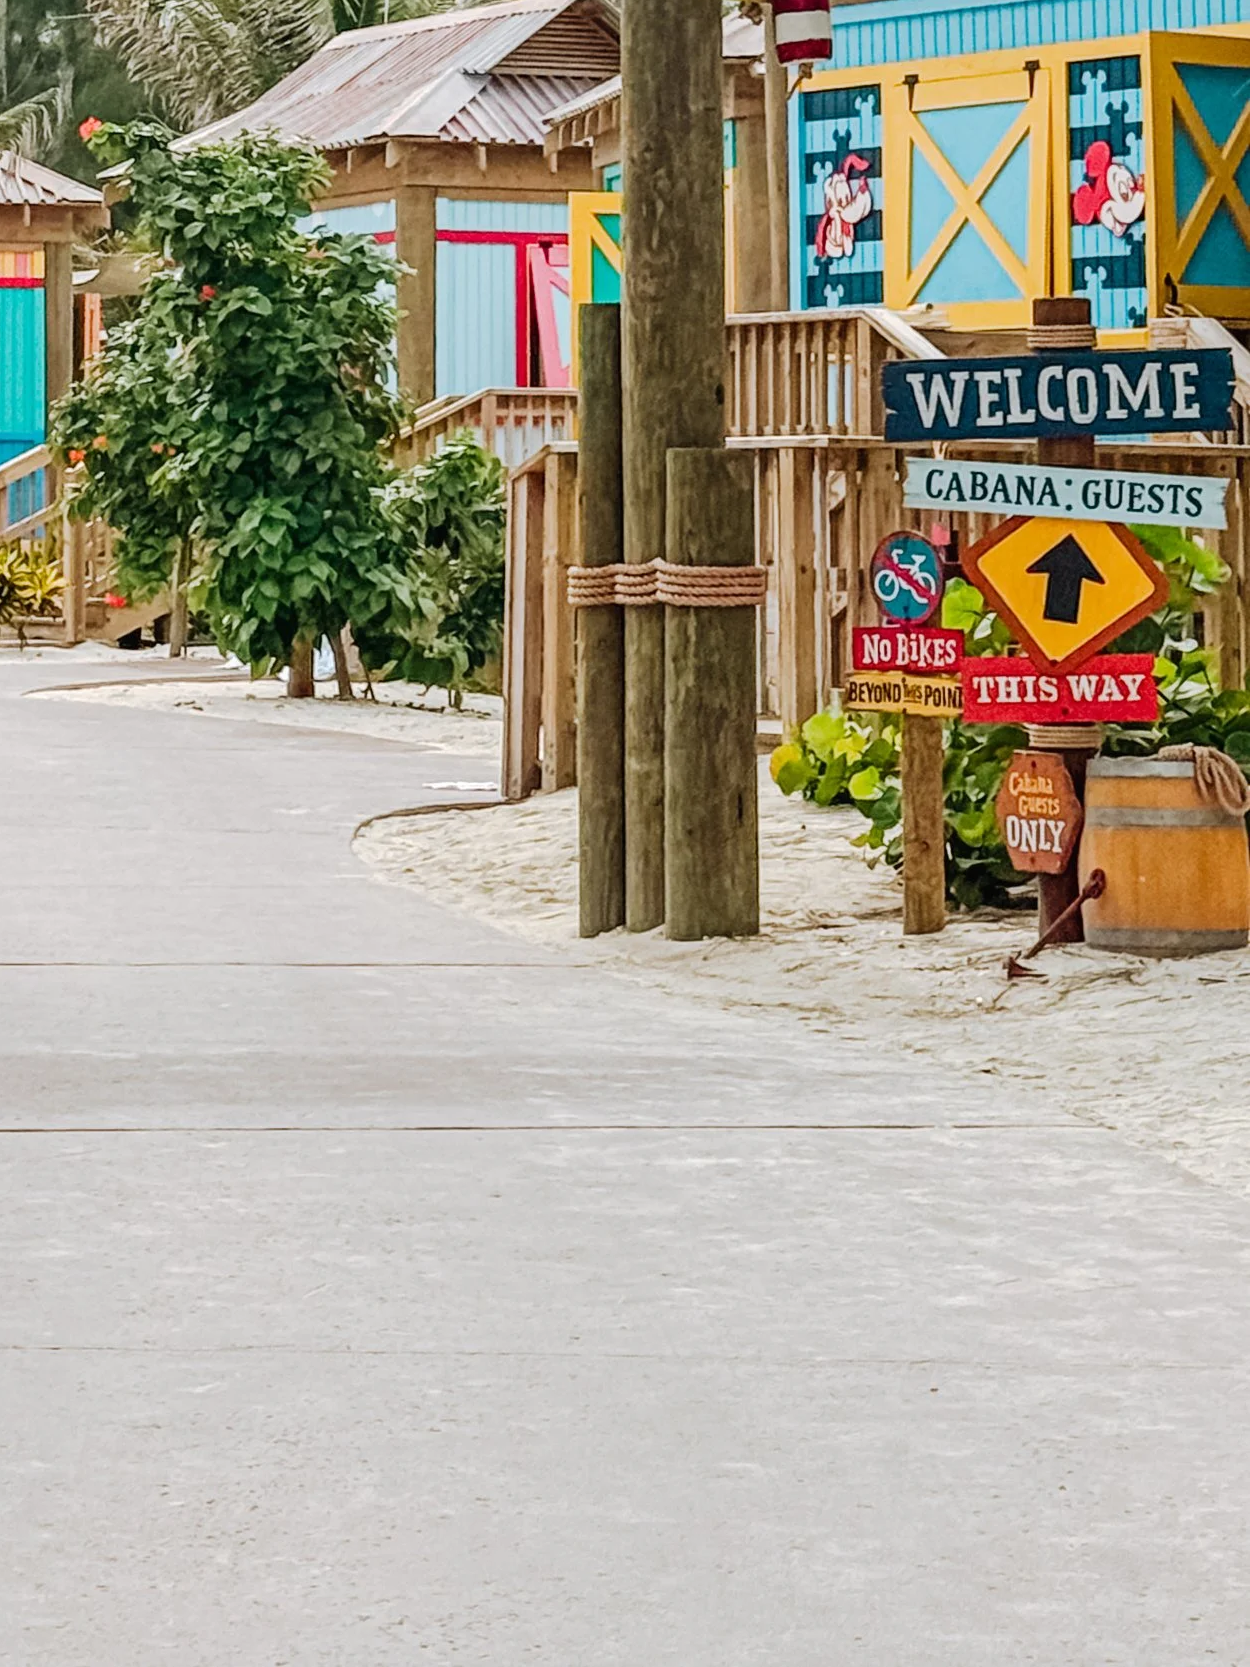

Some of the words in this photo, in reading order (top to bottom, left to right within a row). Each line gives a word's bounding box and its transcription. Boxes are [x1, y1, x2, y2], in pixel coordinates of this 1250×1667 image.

[905, 362, 1201, 429] WELCOME
[1081, 479, 1203, 518] GUESTS
[849, 680, 902, 704] BEYOND
[924, 684, 963, 709] POINT
[972, 675, 1059, 704] THIS
[1066, 674, 1146, 703] WAY
[1006, 815, 1066, 853] ONLY
